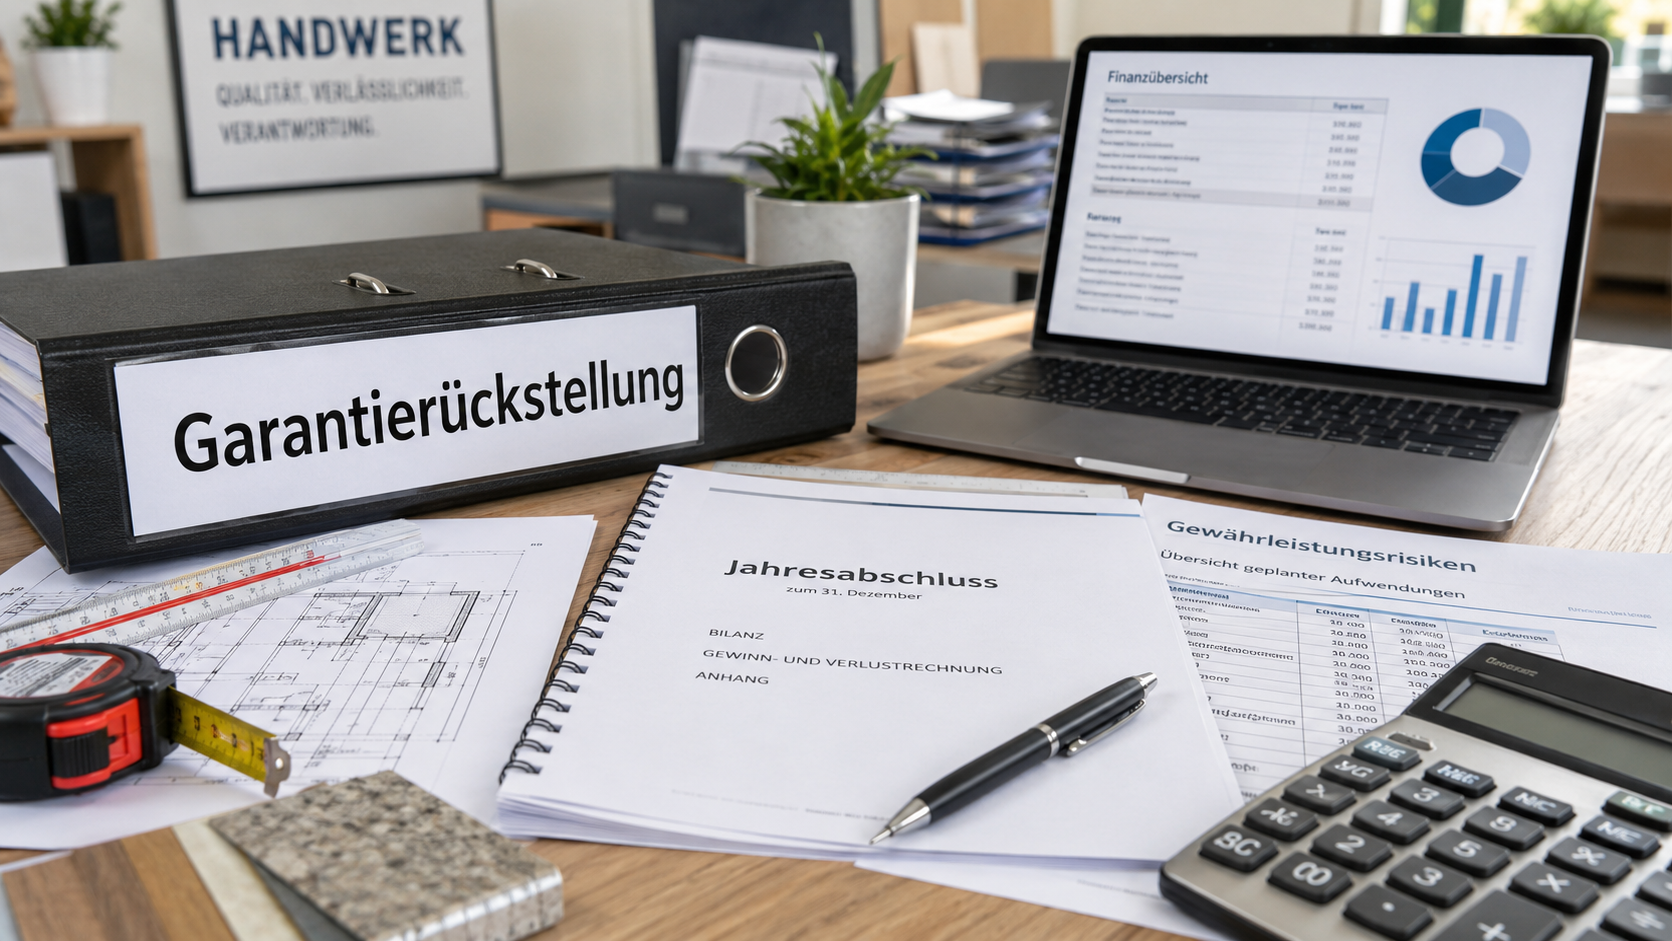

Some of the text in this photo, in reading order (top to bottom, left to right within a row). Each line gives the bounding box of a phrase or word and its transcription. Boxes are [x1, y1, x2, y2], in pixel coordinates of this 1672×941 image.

[211, 16, 464, 60] HANDWERK
[1107, 70, 1209, 85] Finanzübersicht
[173, 359, 684, 472] Garantierückstellung
[1166, 520, 1476, 573] Gewährleistungsrisiken
[723, 559, 999, 589] Jahresabschluss
[1160, 549, 1239, 570] Übersicht
[1243, 563, 1326, 582] geplanter
[1330, 575, 1466, 600] Aufwendungen
[786, 586, 923, 600] zum 31. Dezember
[708, 628, 765, 641] BILANZ
[702, 649, 1003, 675] GEWINN- UND VERLUSTRECHNUNG
[695, 671, 769, 685] ANHANG
[1334, 834, 1366, 855] 2
[1412, 866, 1444, 888] 3
